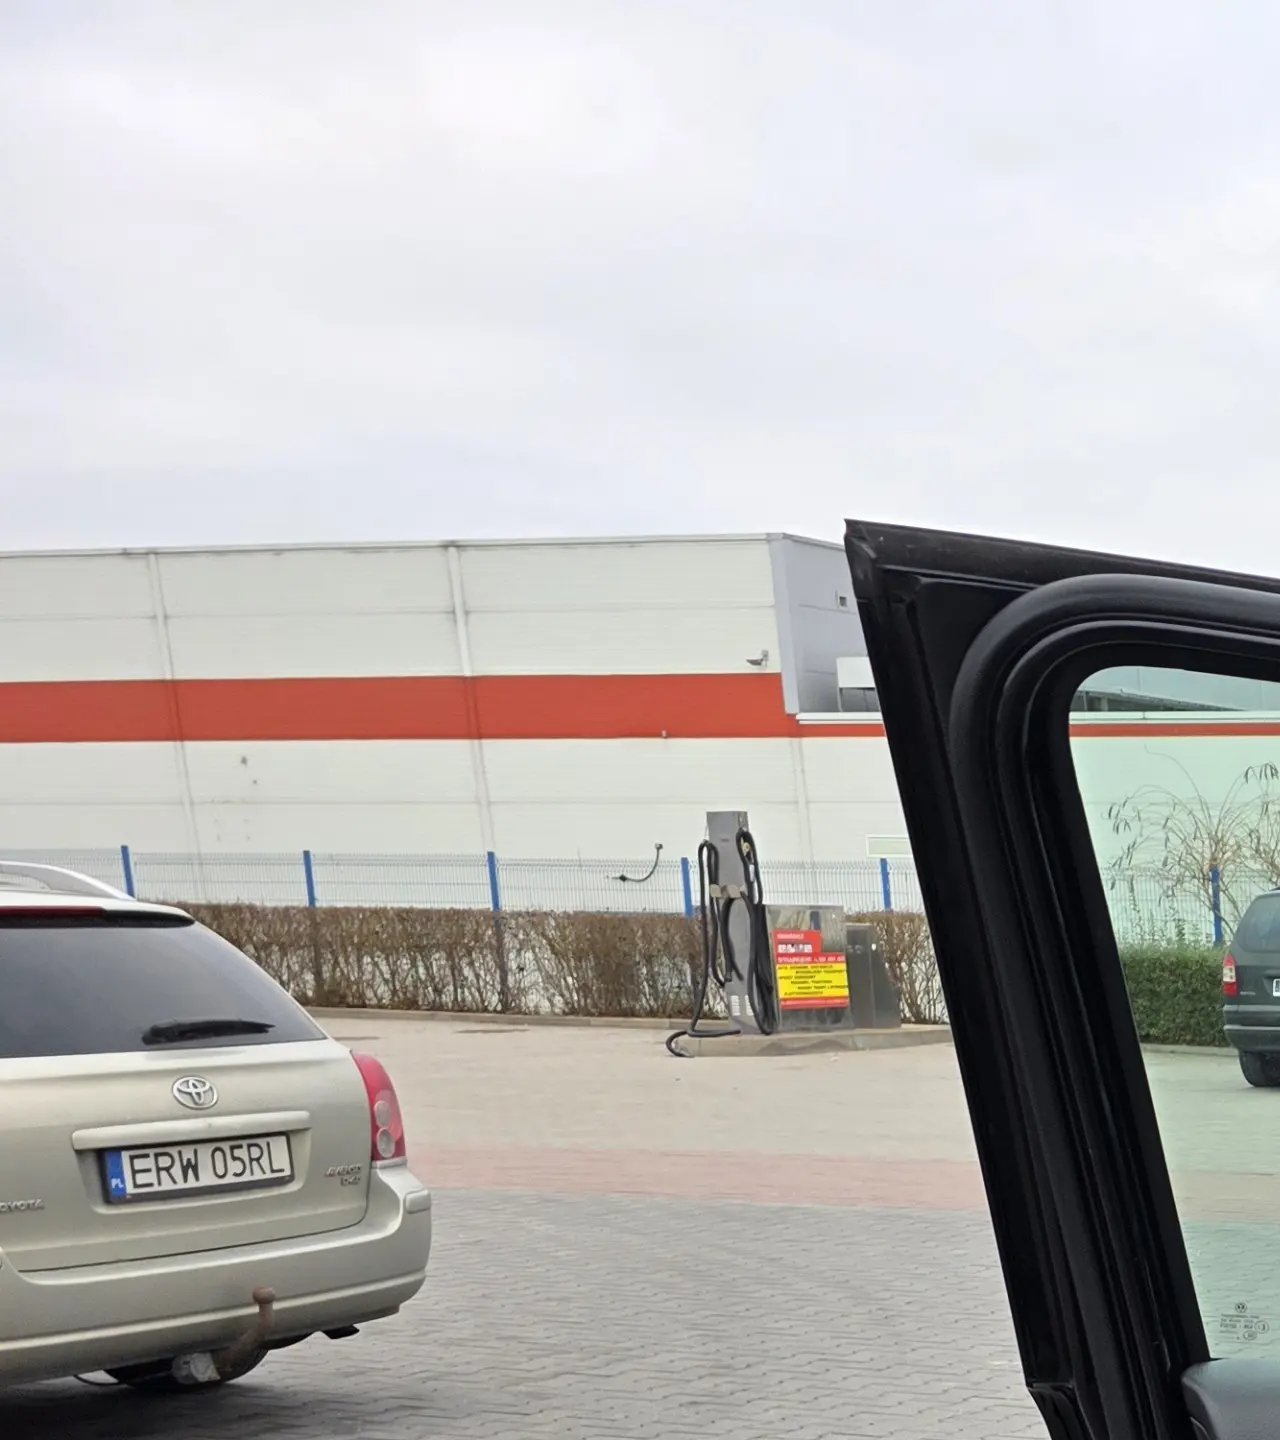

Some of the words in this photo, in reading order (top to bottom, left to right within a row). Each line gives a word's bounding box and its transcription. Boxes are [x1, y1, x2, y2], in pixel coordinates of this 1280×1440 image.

[128, 1148, 200, 1189] ERW
[210, 1142, 285, 1180] 05RL
[111, 1178, 124, 1189] PL
[0, 1198, 44, 1212] OYOTA
